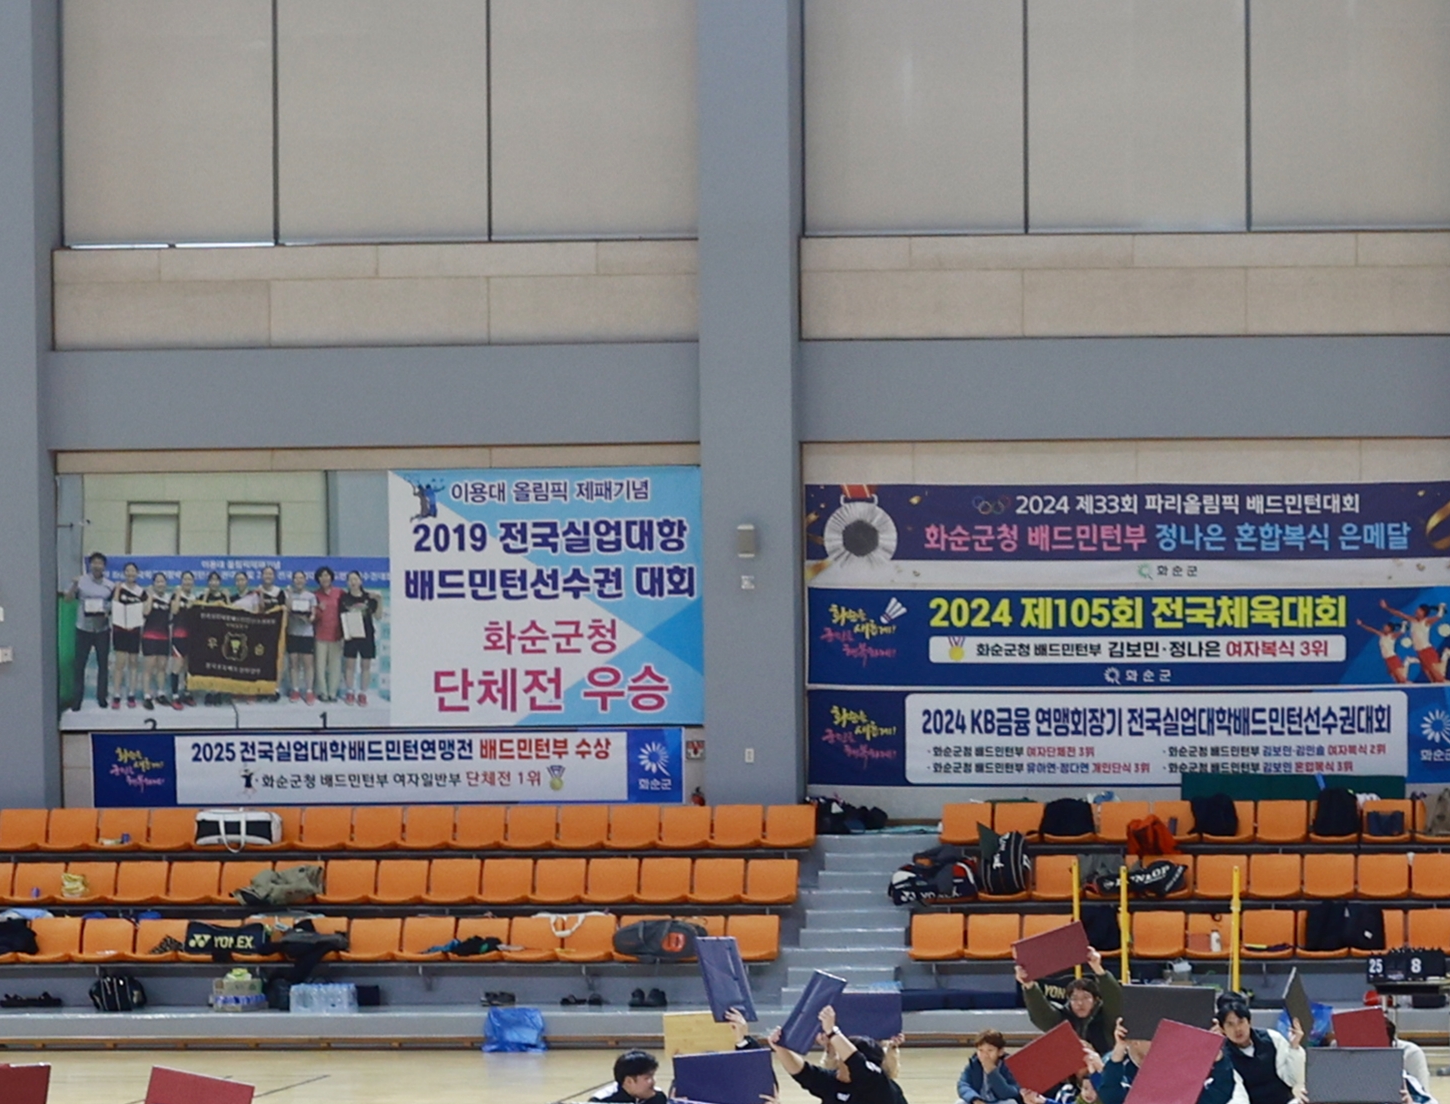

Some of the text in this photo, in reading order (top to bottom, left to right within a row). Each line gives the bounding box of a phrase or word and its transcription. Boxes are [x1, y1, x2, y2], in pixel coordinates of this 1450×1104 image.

[451, 477, 649, 503] 이용대 올림픽 제패기념
[1015, 493, 1360, 515] 2024 제33회 파리올림픽 배드민턴대회
[413, 518, 688, 554] 2019 전국실업대항
[924, 521, 1412, 552] 화순군청 배드민턴부 정나은 혼합복식 은메달
[404, 566, 624, 602] 배드민턴선수권
[635, 564, 696, 598] 대회
[929, 595, 1347, 630] 2024 제105회 전국체육대회
[482, 617, 619, 655] 화순군청
[976, 643, 1031, 658] 화순군청
[1034, 643, 1102, 658] 배드민턴부
[1226, 640, 1296, 658] 여자복식
[1300, 640, 1329, 657] 3위
[433, 664, 671, 713] 단체전 우승
[921, 705, 1391, 737] 2024 KB금융 연맹회장기 전국실업대학배드민턴선수권대회
[191, 737, 612, 763] 2025 전국실업대학배드민턴연맹전 배드민턴부 수상
[261, 770, 542, 789] 화순군청 배드민턴부 여자일반부 단체전 1위
[1369, 958, 1422, 973] 25 8
